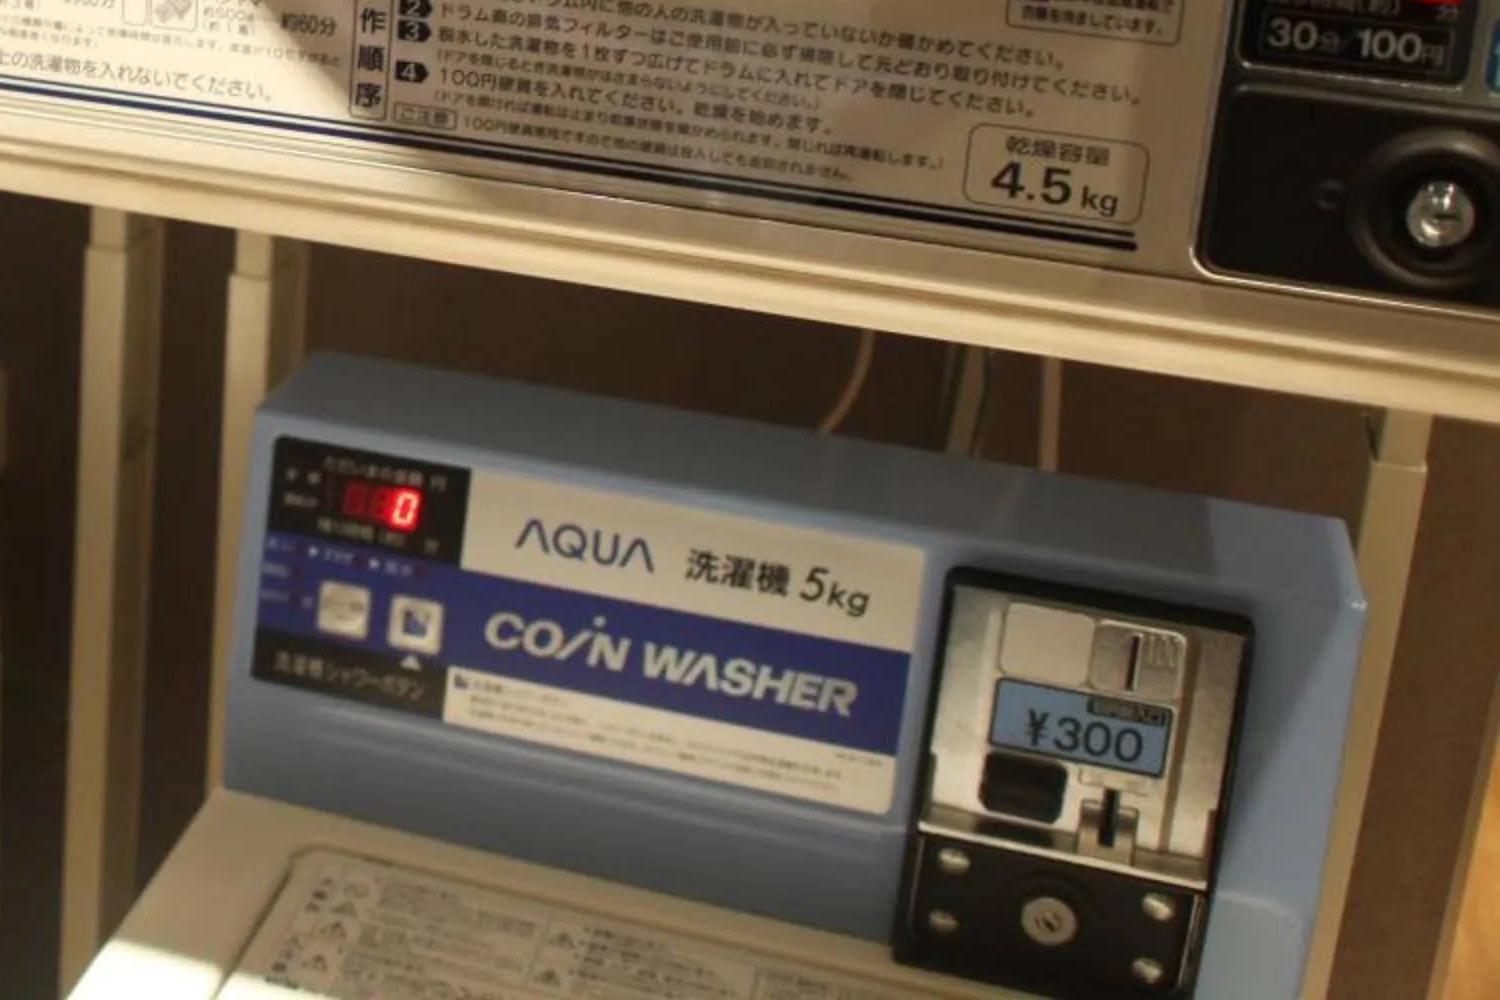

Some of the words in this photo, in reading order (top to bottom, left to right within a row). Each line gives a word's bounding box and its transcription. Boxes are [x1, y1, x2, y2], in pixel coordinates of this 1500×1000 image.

[1005, 134, 1111, 168] 乾燥容量
[391, 488, 420, 525] 0
[514, 519, 656, 574] AQUA
[685, 548, 791, 597] 洗濯機
[799, 567, 871, 619] 5kg
[484, 613, 632, 672] COIN
[642, 643, 859, 718] WASHER
[1025, 708, 1144, 764] ¥300
